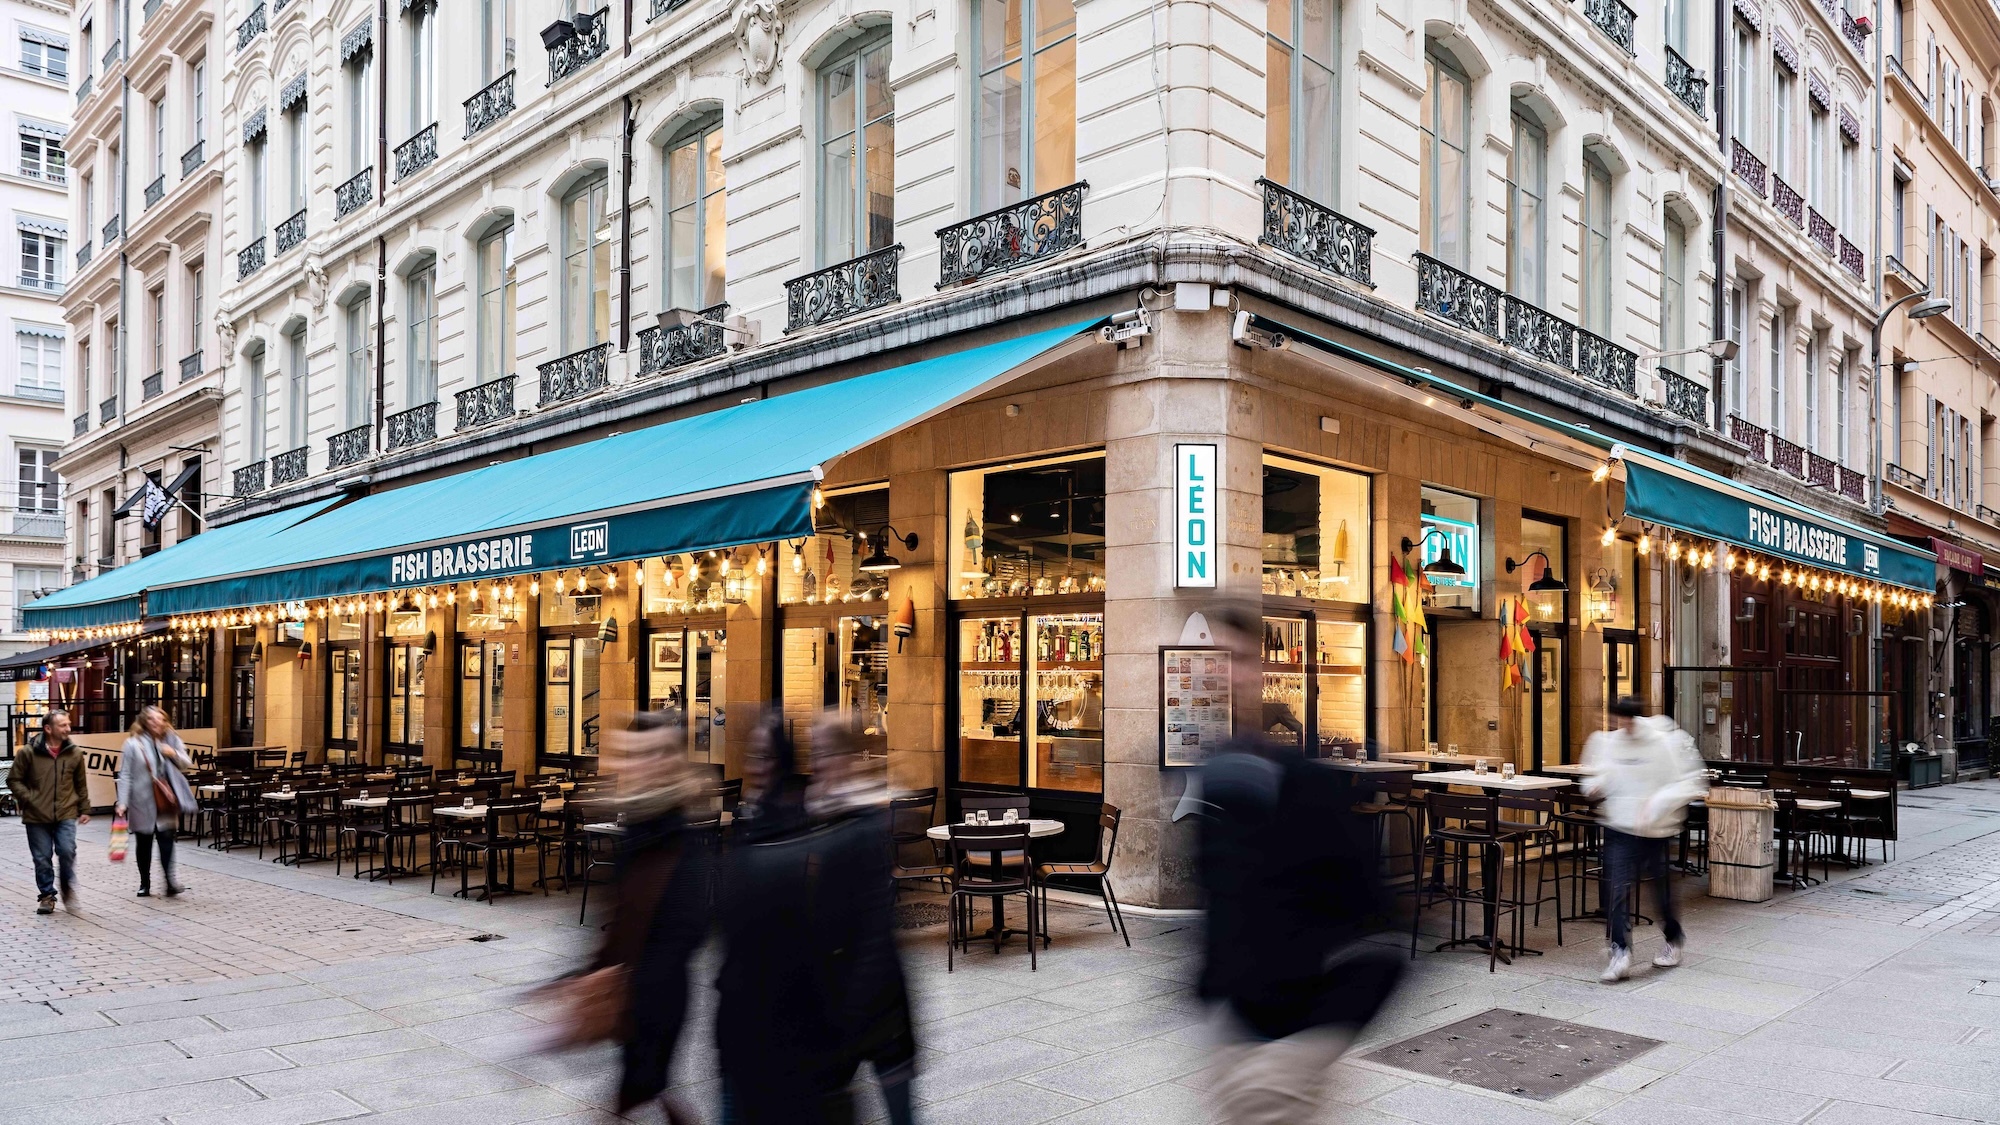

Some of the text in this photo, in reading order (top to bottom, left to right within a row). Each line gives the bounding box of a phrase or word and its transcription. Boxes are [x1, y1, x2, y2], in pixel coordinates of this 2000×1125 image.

[574, 528, 604, 553] LÉON
[1188, 454, 1206, 578] LÉON
[1749, 507, 1847, 566] FISH BRASSERIE
[391, 534, 533, 583] FISH BRASSERIE
